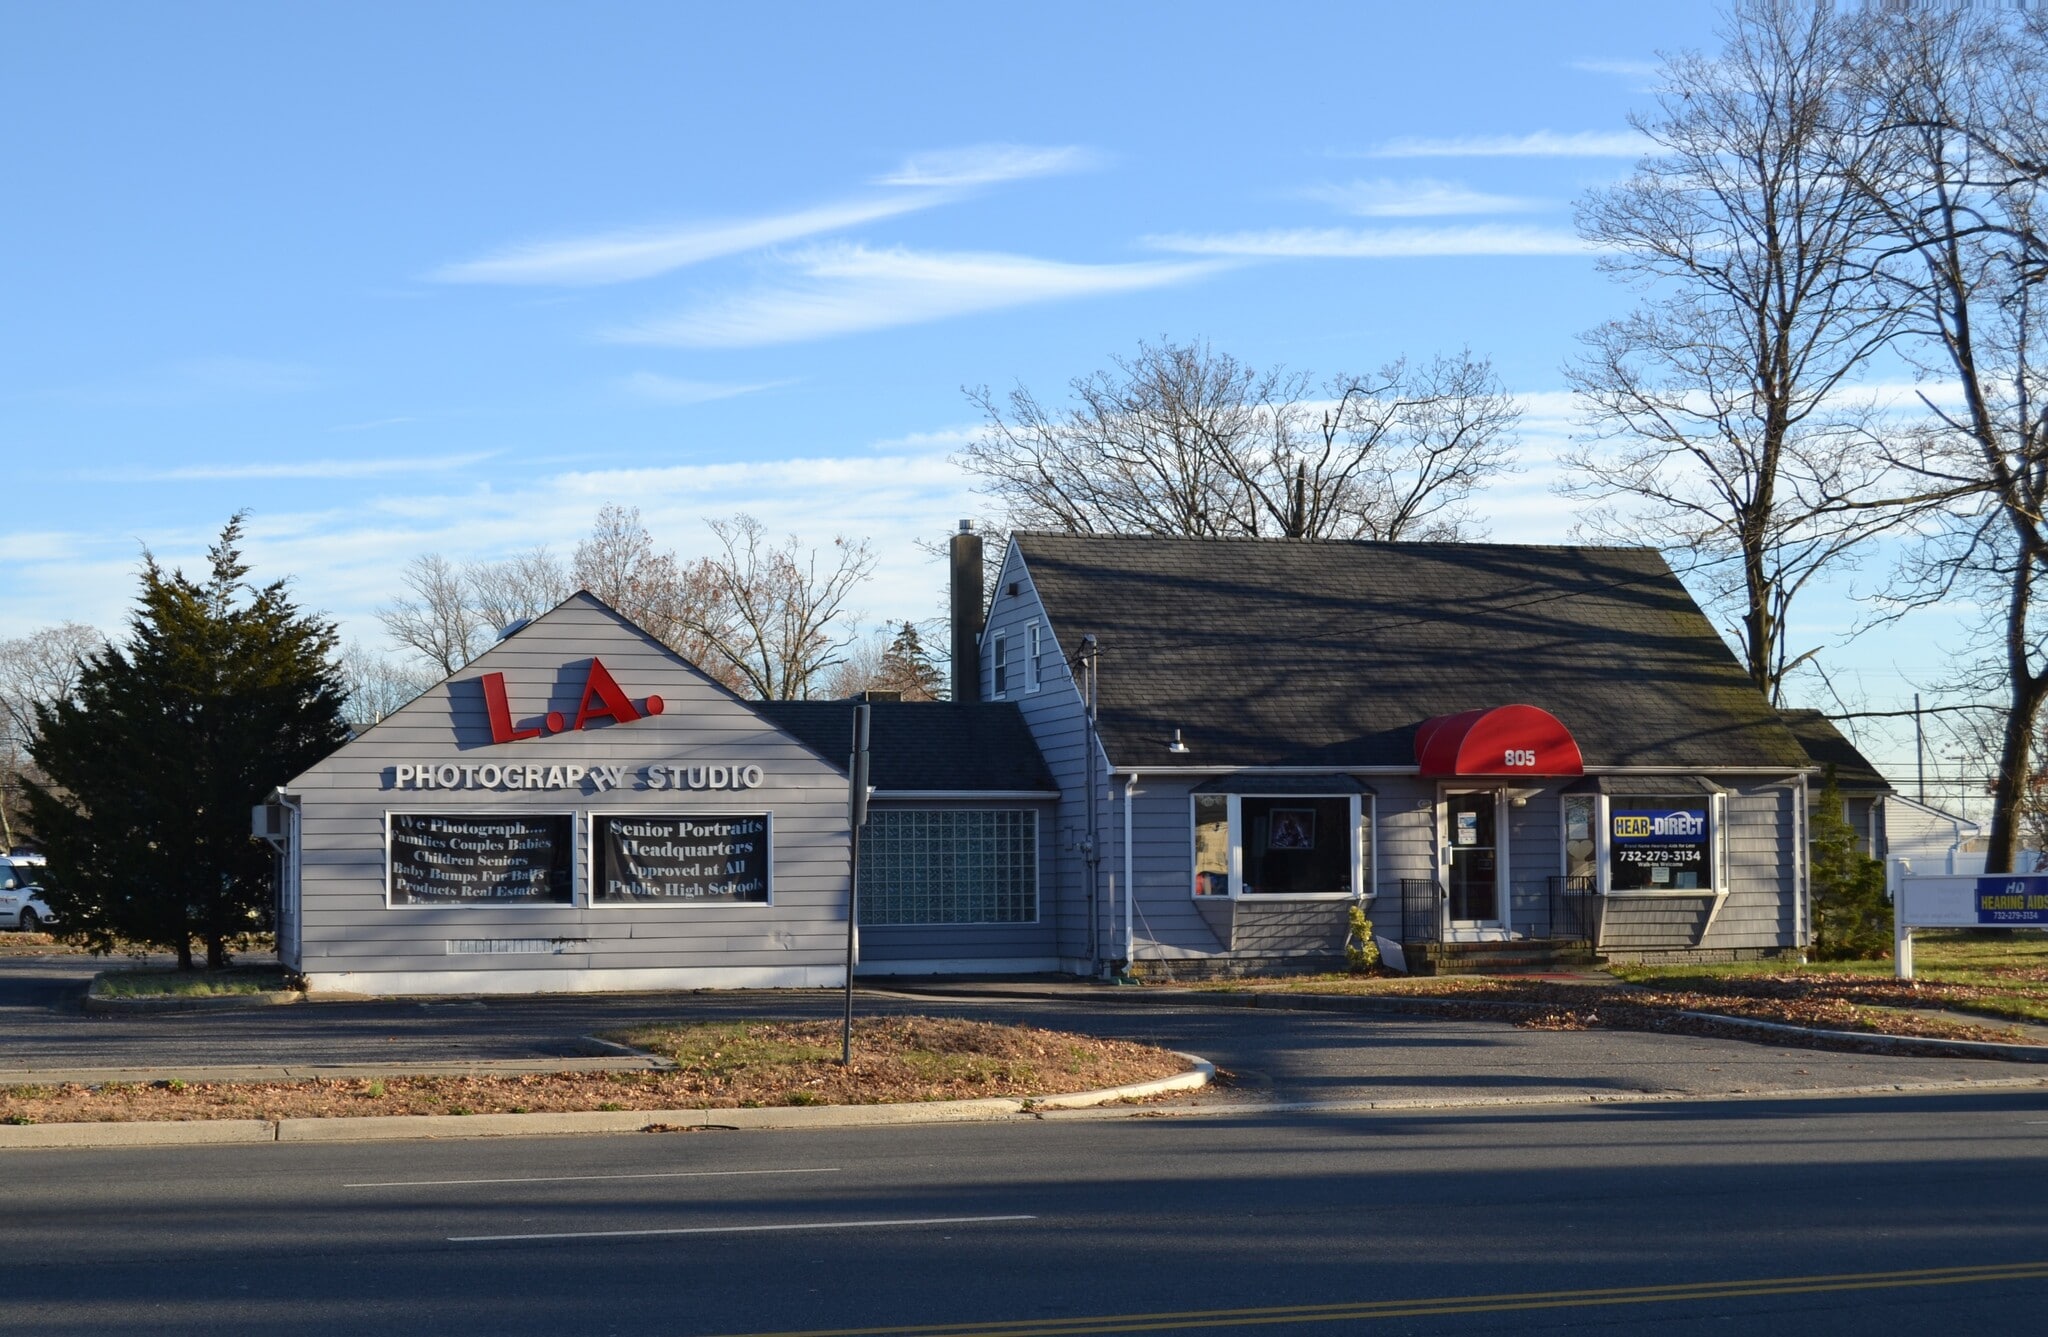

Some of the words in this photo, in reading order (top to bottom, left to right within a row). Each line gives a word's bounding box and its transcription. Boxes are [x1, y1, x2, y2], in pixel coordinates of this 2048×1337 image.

[481, 656, 664, 744] L.A.
[1504, 750, 1536, 767] 805
[395, 763, 628, 793] PHOTOGRAPHY
[647, 764, 765, 789] STUDIO
[400, 815, 426, 830] We
[609, 818, 673, 837] Senior
[678, 819, 764, 838] Portraits
[391, 829, 446, 848] Families
[450, 837, 504, 853] Couples
[508, 838, 552, 851] Babies
[622, 839, 753, 861] Headquarters
[414, 850, 474, 866] Children
[477, 855, 529, 867] Seniors
[1620, 851, 1701, 861] 732-279-3134
[393, 861, 426, 880] Baby
[430, 868, 478, 884] Bumps
[482, 871, 507, 882] Fur
[626, 861, 700, 880] Approved
[703, 865, 719, 876] at
[724, 860, 746, 875] All
[396, 878, 457, 896] Products
[461, 885, 492, 897] Real
[496, 886, 539, 897] Estate
[609, 880, 661, 896] Public
[665, 883, 704, 899] High
[708, 877, 764, 895] Schools
[2005, 882, 2025, 893] HD
[1981, 895, 2024, 910] HEARING
[1993, 911, 2038, 920] 732-279-3134
